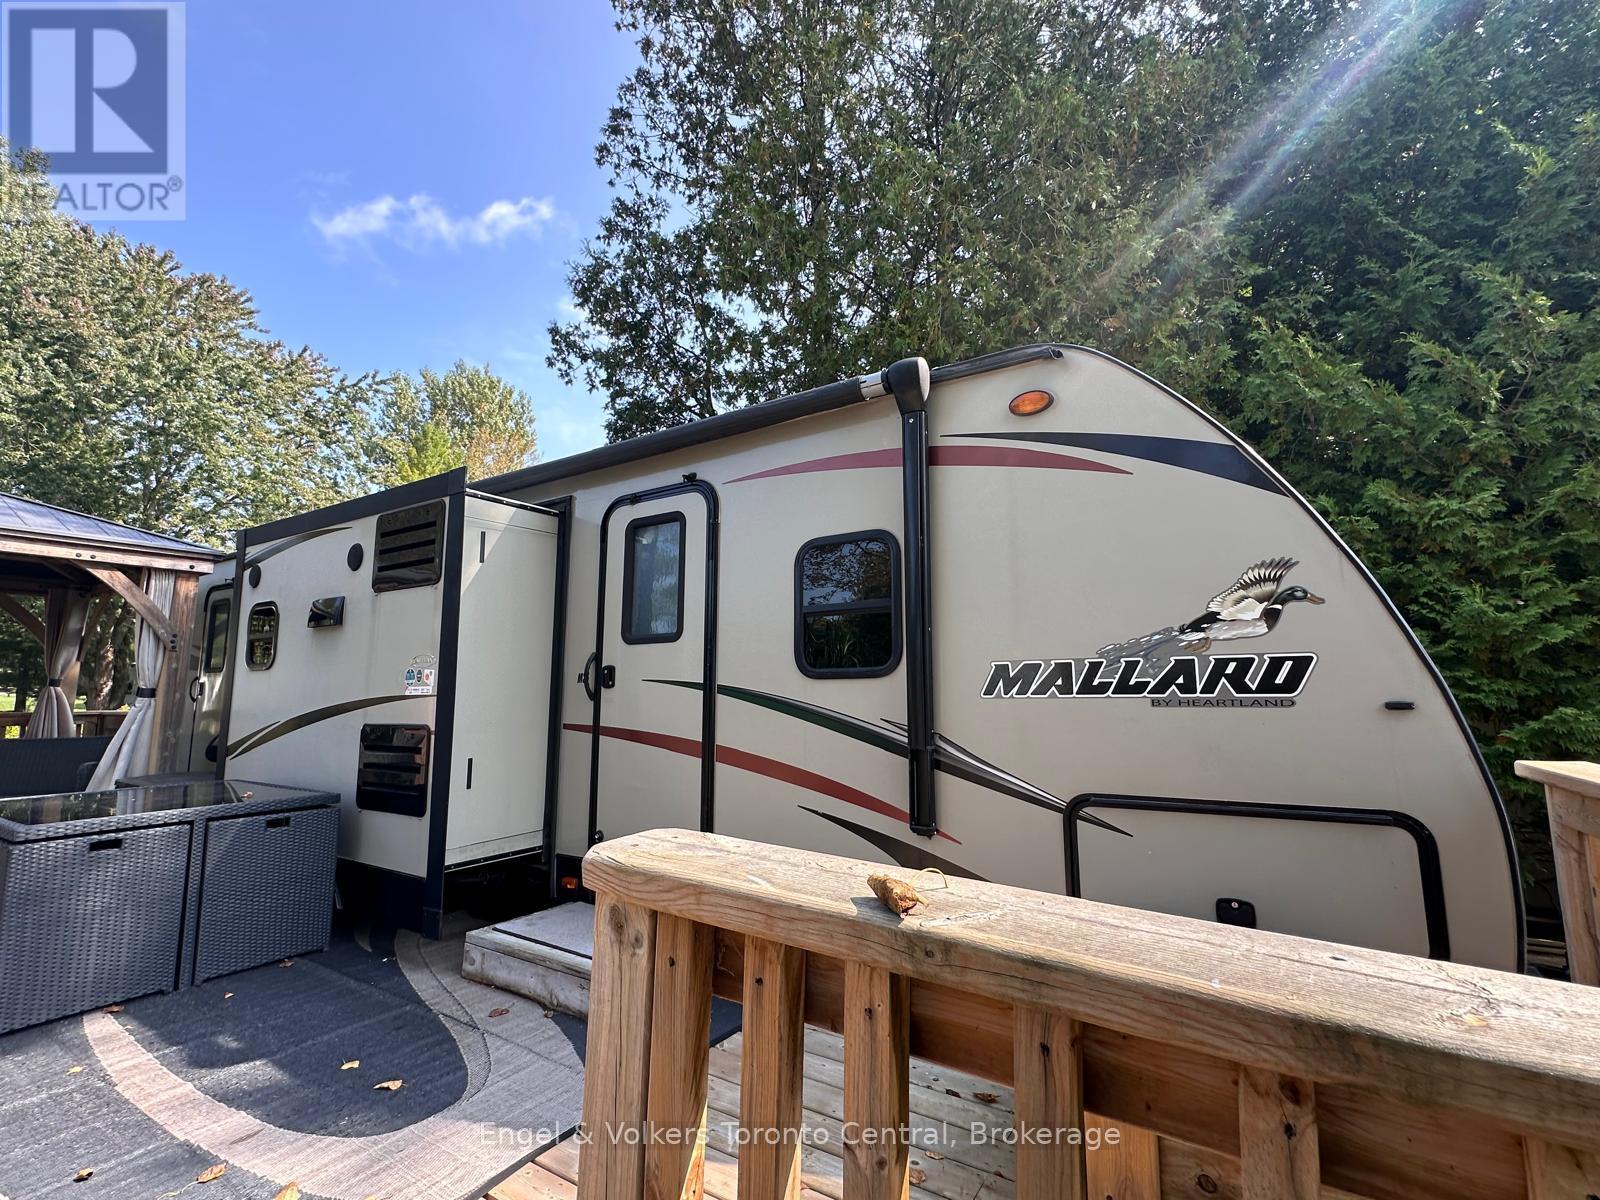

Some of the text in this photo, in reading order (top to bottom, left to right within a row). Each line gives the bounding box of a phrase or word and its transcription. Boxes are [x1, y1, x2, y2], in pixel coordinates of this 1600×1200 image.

[981, 652, 1318, 699] MALLARD
[1151, 698, 1296, 708] BY HEARTLAND
